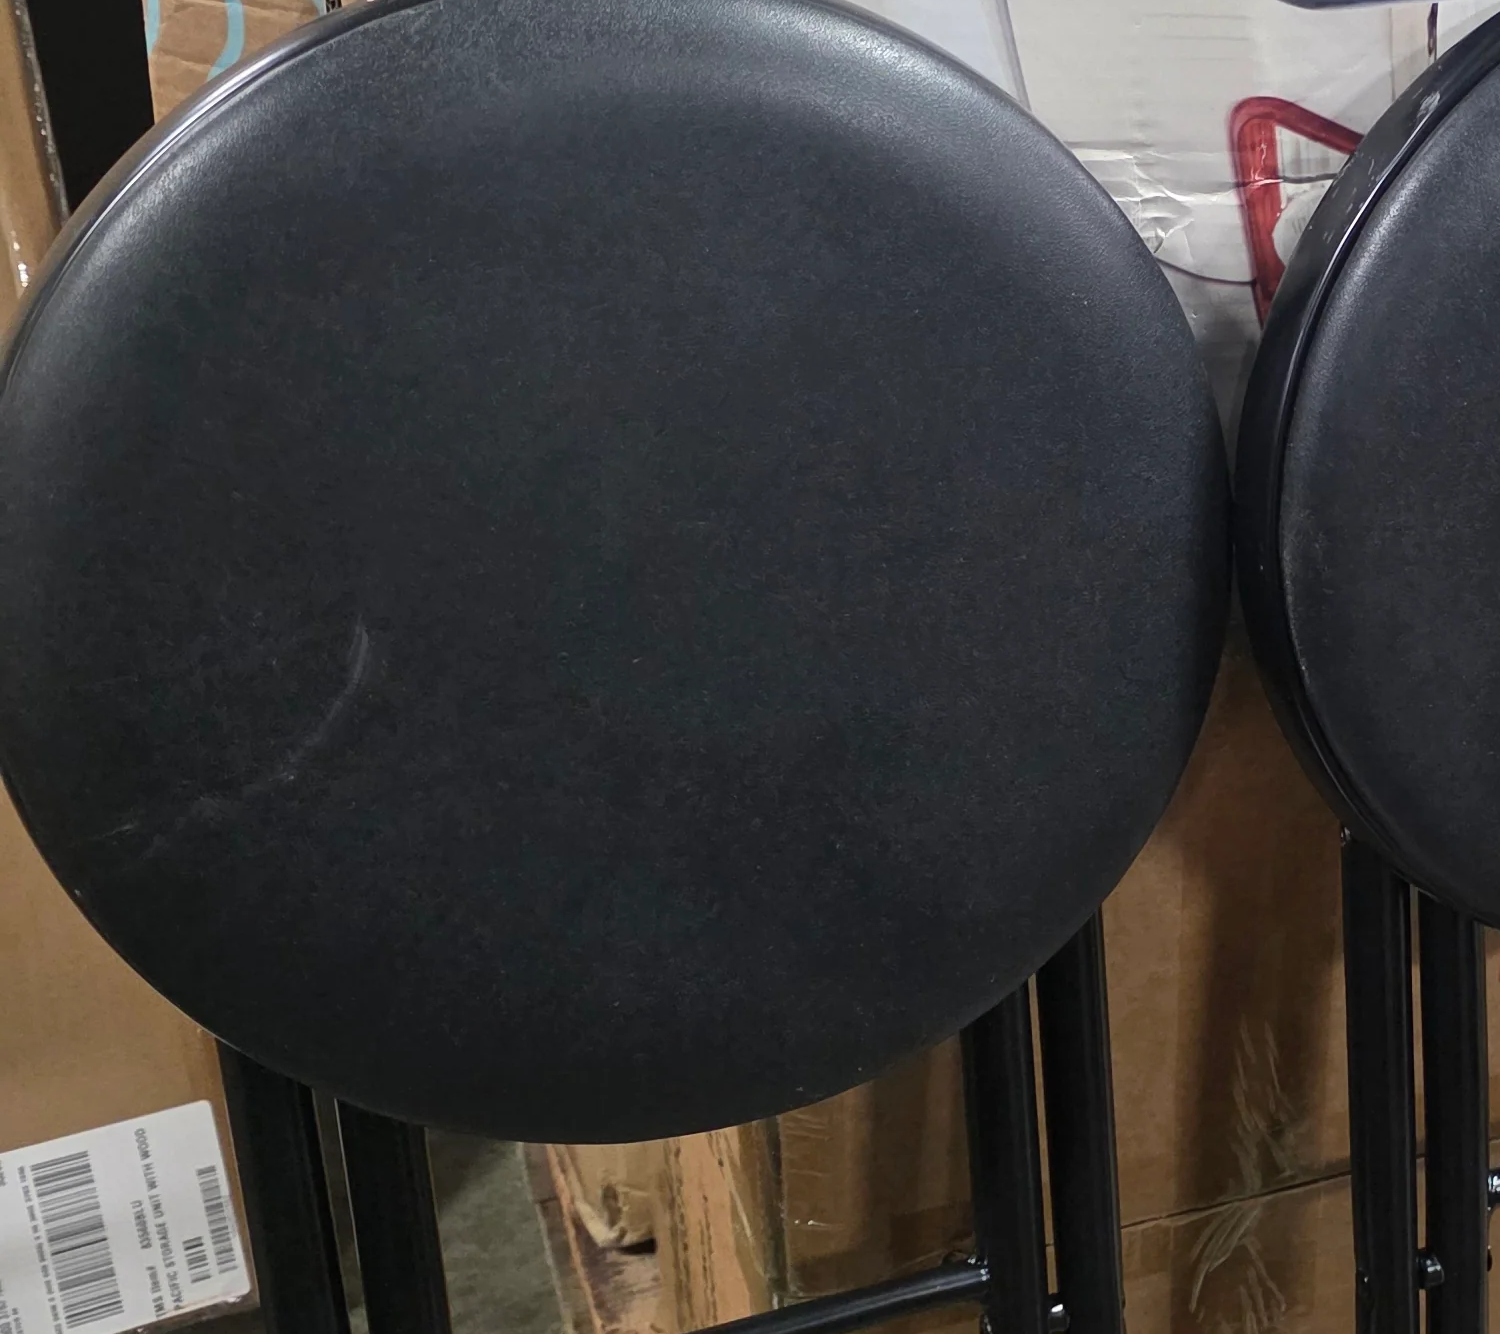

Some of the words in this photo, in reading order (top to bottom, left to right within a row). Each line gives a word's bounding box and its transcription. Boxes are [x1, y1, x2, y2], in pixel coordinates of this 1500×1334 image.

[134, 1127, 152, 1160] WOOD
[142, 1163, 158, 1192] WITH
[154, 1222, 177, 1269] STORAGE
